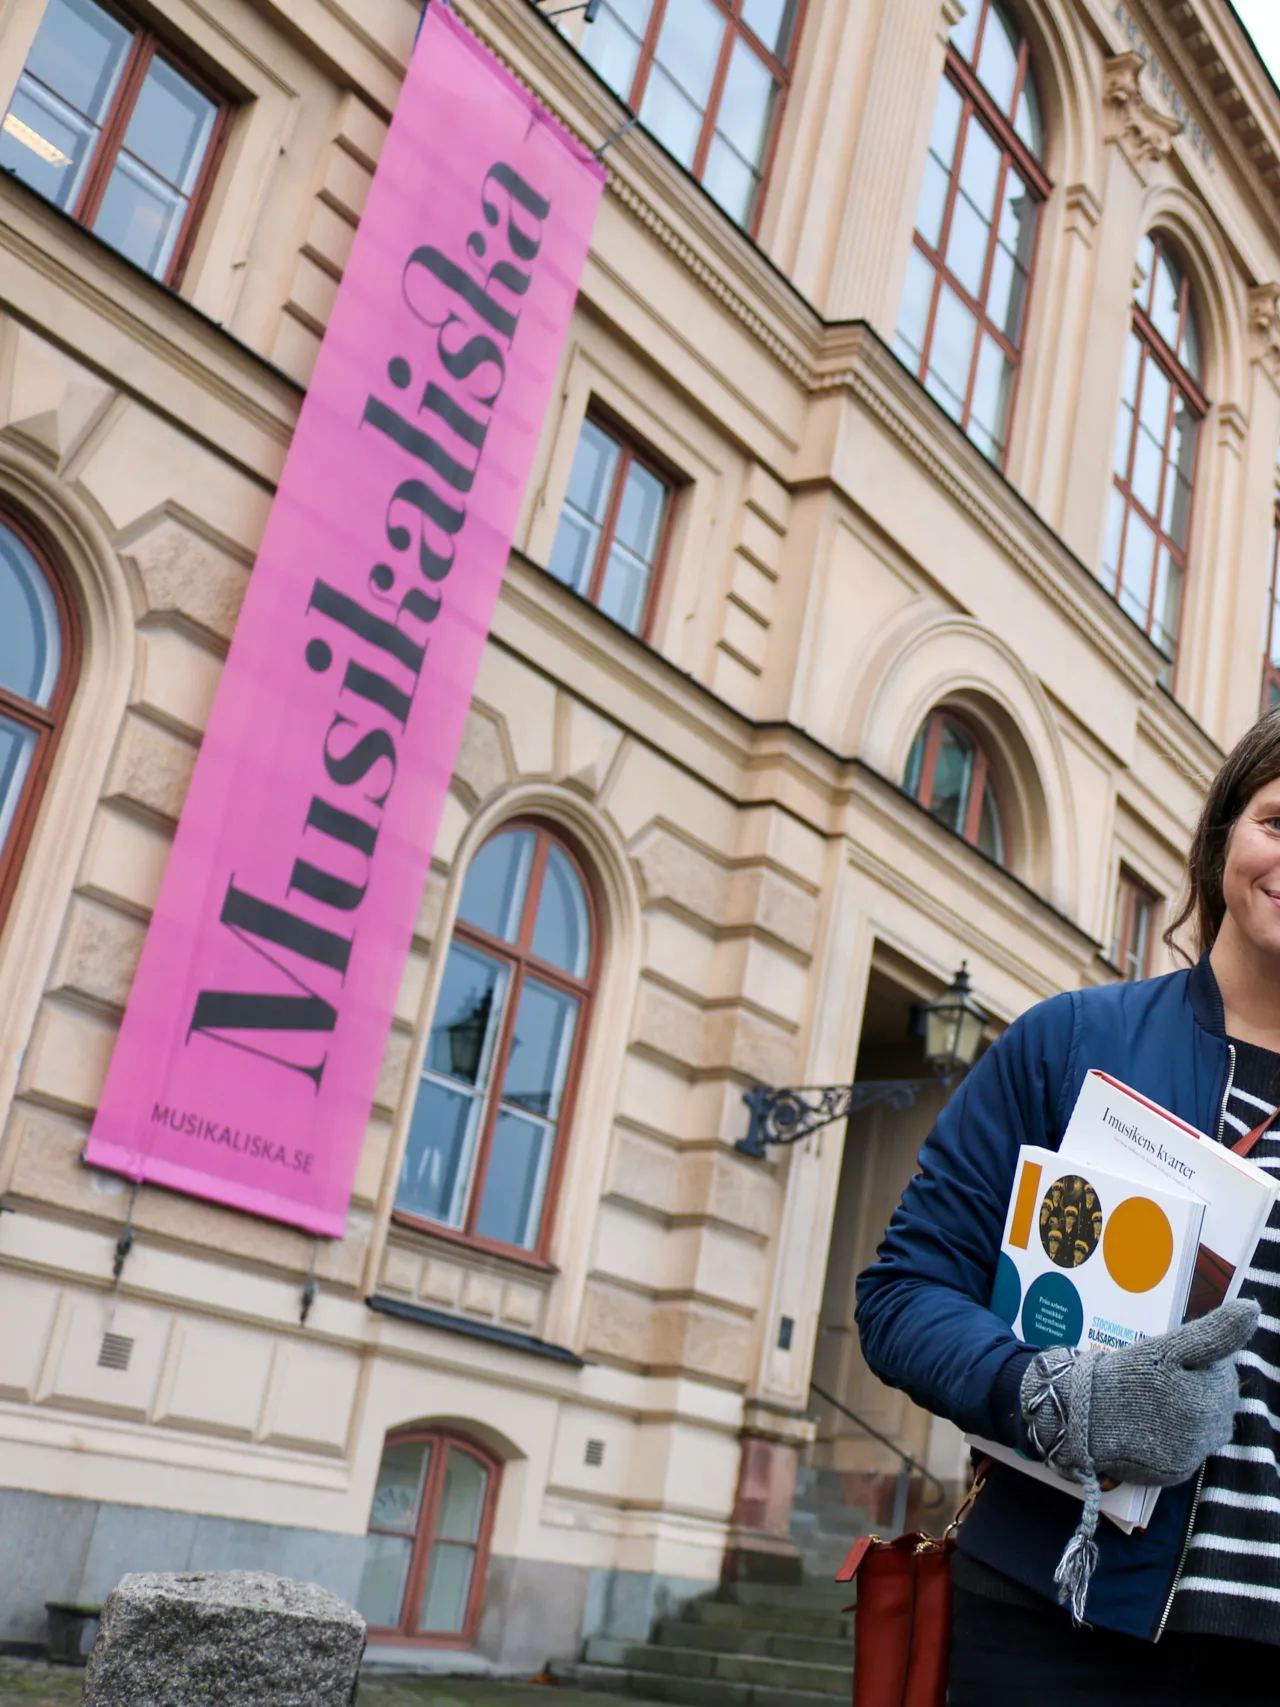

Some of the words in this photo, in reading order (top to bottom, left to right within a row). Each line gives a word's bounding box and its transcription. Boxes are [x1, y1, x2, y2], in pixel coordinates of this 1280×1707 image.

[185, 161, 552, 1097] Musikaliska
[150, 1102, 315, 1176] MUSIKALISKA.SE
[1102, 1107, 1110, 1122] I
[1108, 1114, 1155, 1154] musikens
[1156, 1144, 1196, 1180] kvarter
[1092, 1315, 1135, 1341] STOCKHOLMS
